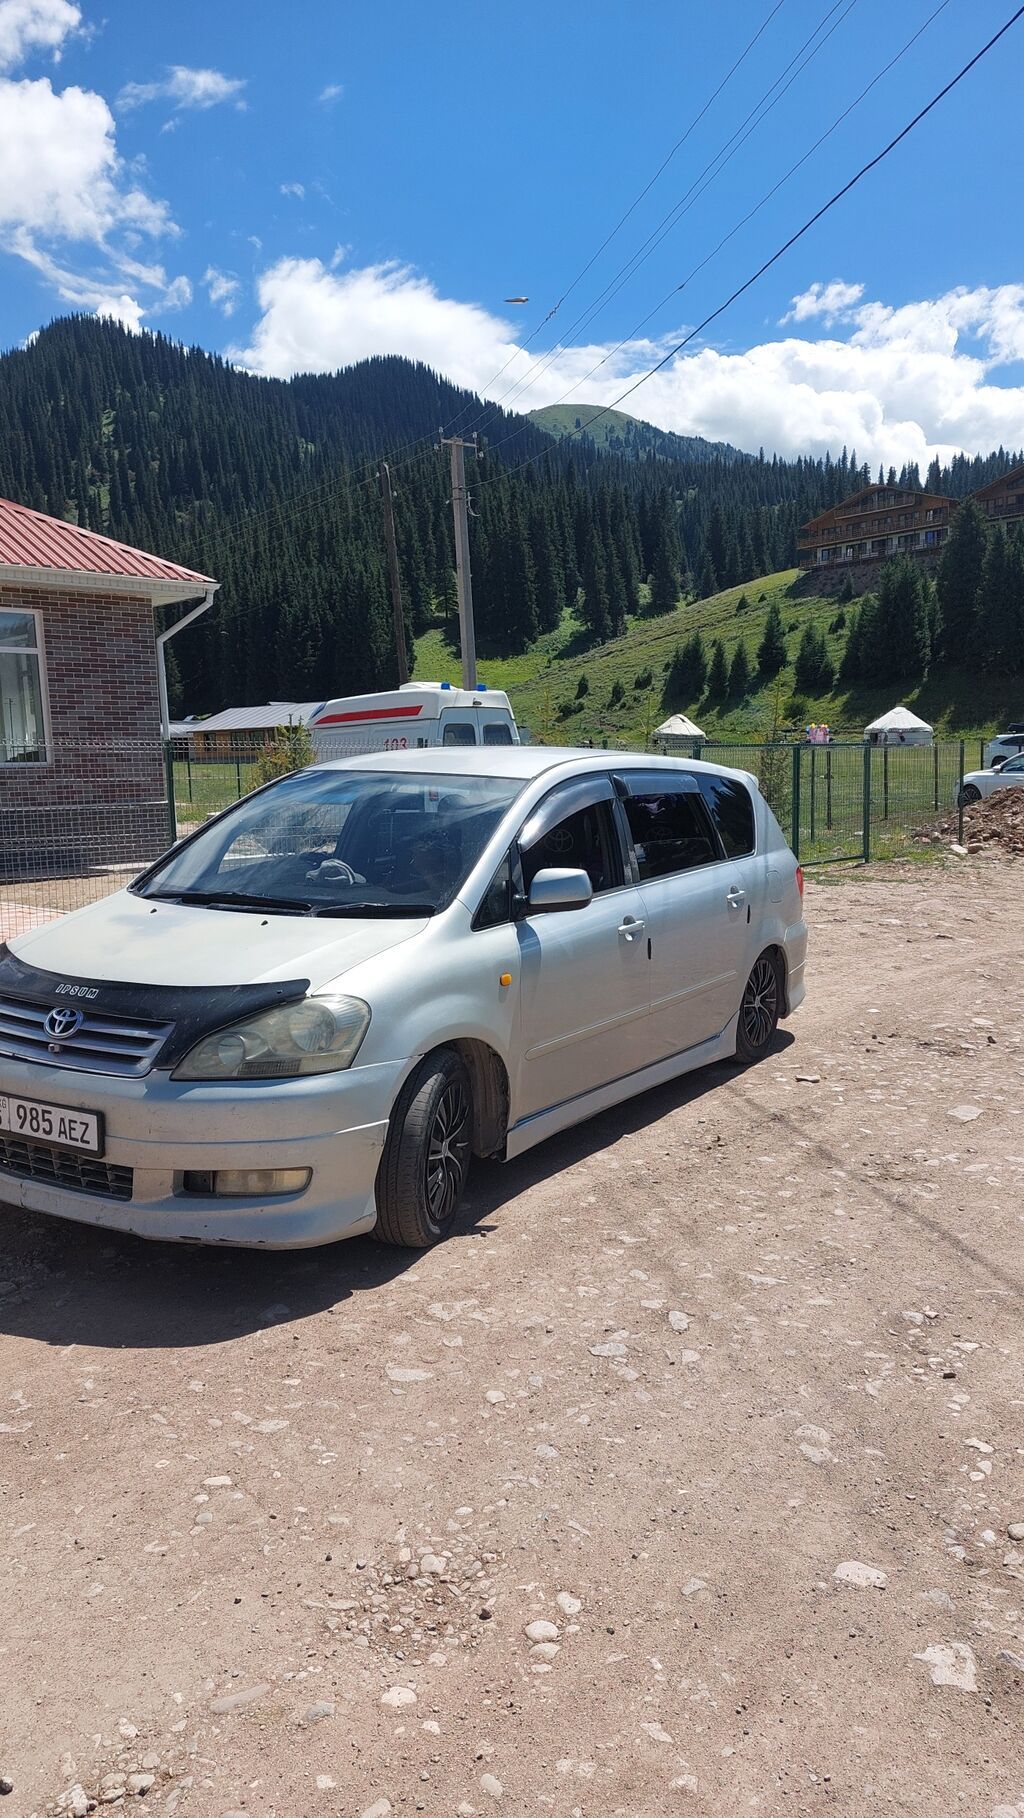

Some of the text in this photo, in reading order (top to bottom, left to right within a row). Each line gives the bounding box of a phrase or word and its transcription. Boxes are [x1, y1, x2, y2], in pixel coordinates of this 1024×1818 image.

[55, 983, 99, 999] IPSUM
[16, 1104, 53, 1136] 985
[58, 1117, 91, 1145] AEZ
